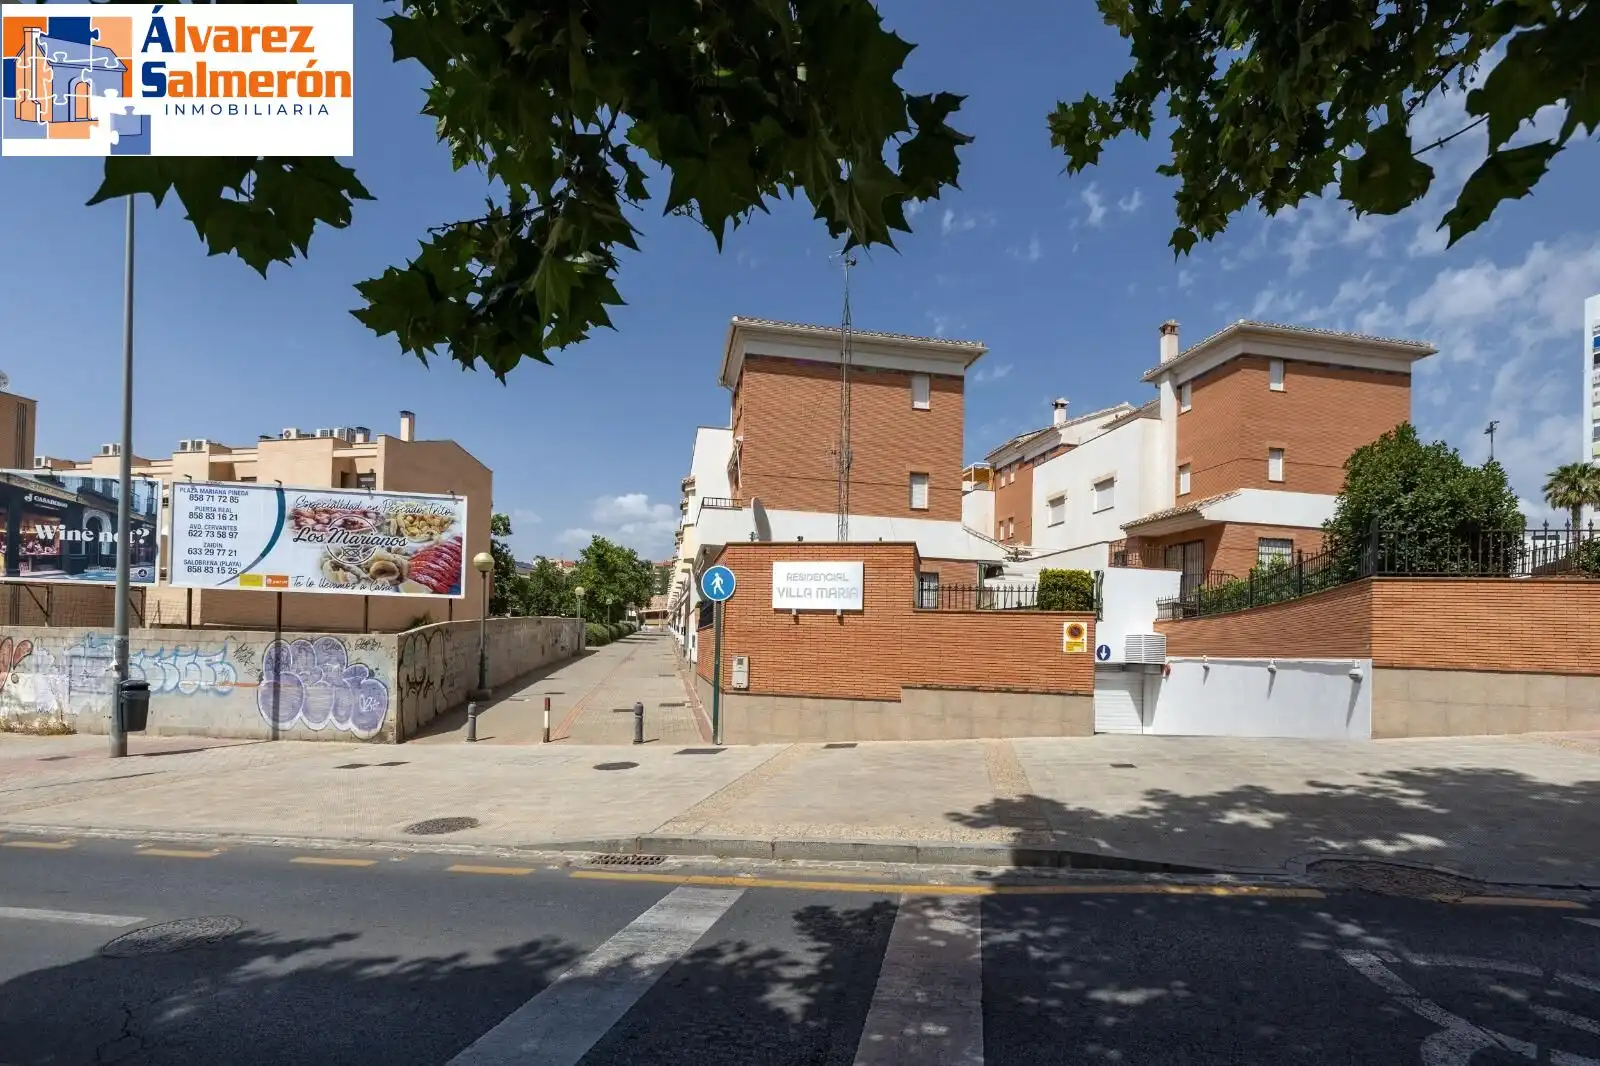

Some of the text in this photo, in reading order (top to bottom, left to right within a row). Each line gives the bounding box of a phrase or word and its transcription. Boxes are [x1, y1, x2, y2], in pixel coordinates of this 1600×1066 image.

[189, 494, 204, 502] 858
[218, 495, 227, 503] 72
[229, 496, 239, 504] 85
[205, 513, 215, 521] 83
[217, 513, 227, 521] 16
[35, 524, 94, 542] Wine
[188, 530, 239, 540] 622 73 58 97
[293, 527, 408, 547] Los Marianos
[187, 548, 237, 557] 633 29 77 21
[216, 567, 226, 575] 15
[786, 572, 849, 582] RESIDENCIAL
[776, 587, 859, 599] VILLA MARIA
